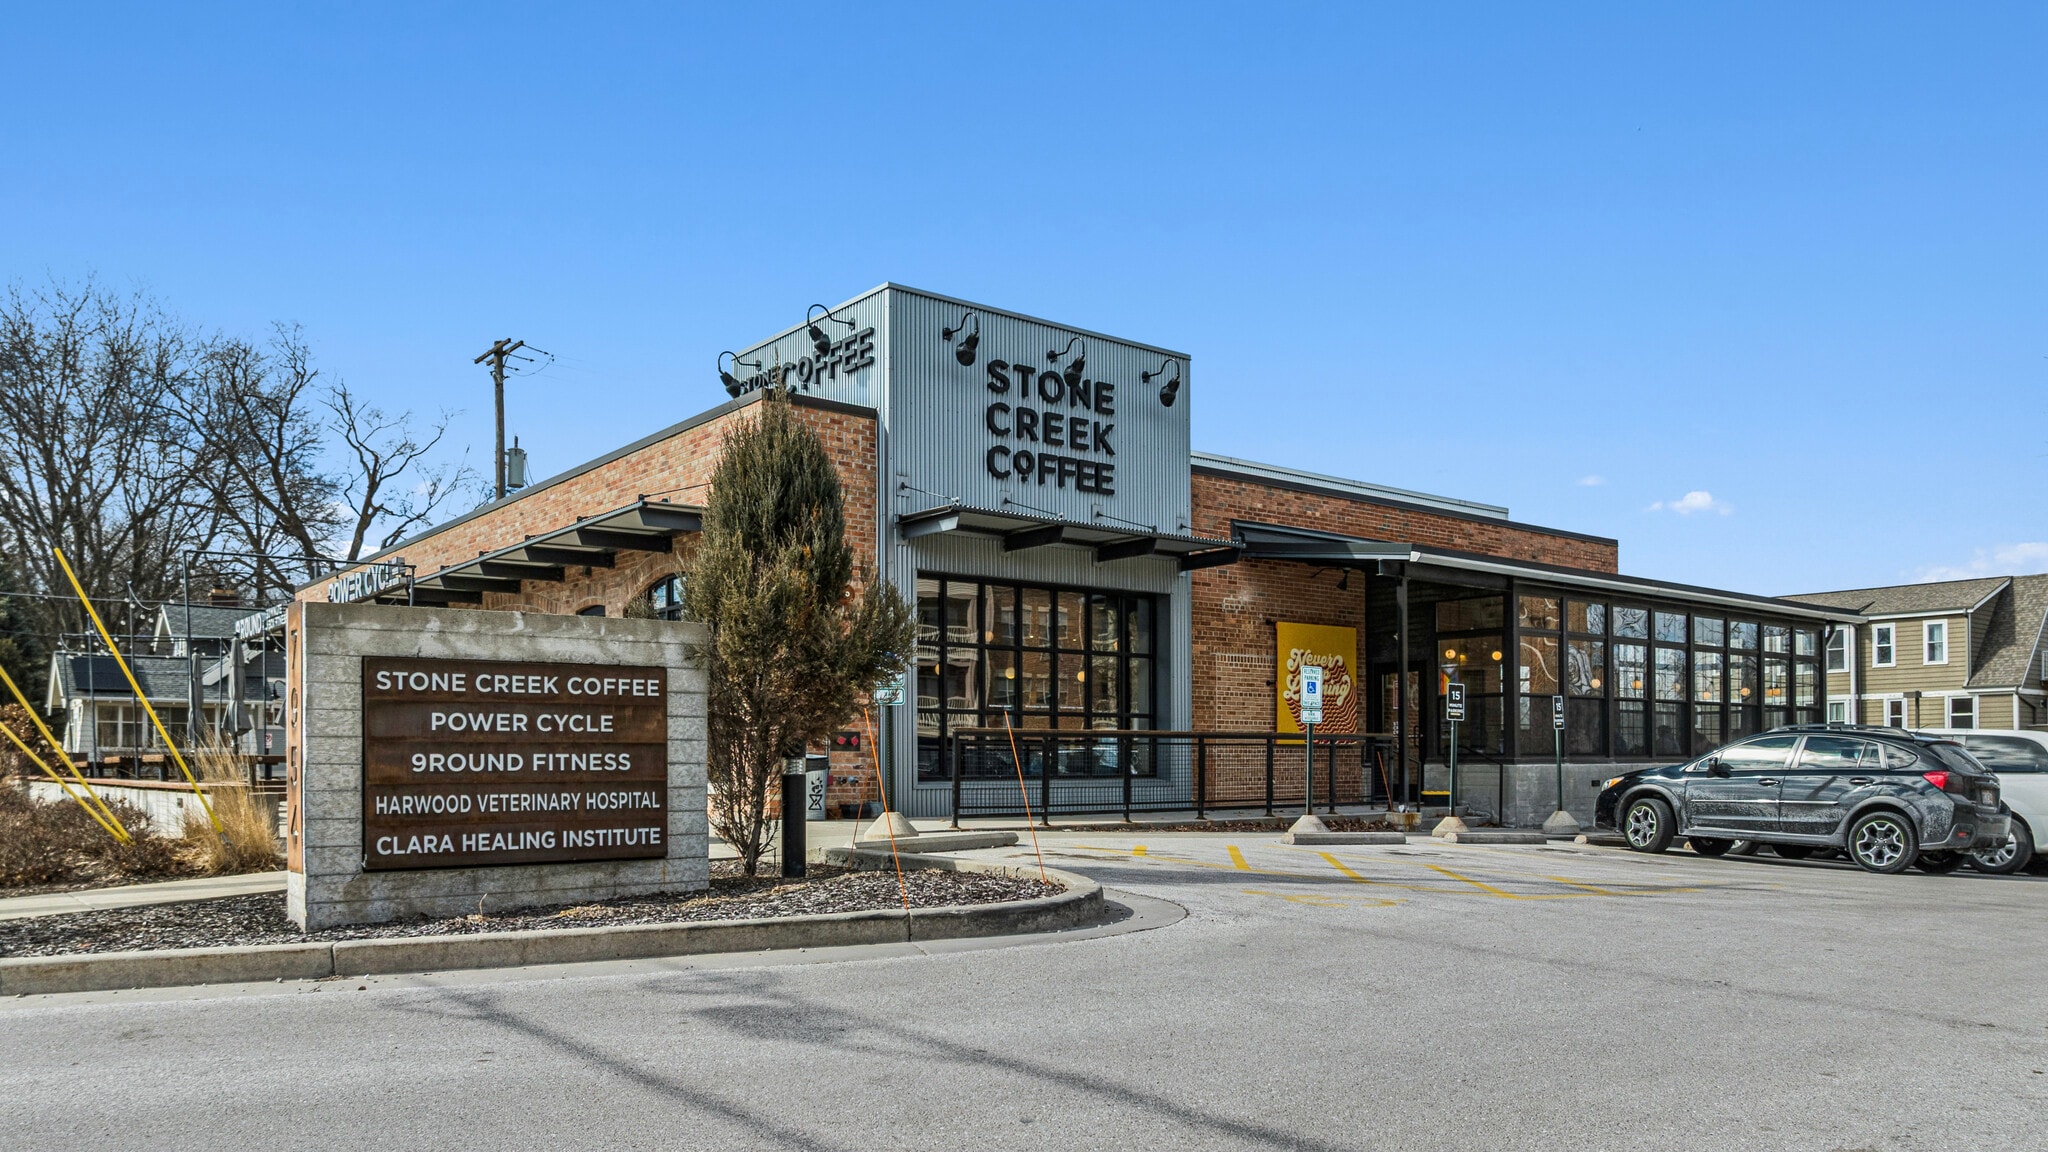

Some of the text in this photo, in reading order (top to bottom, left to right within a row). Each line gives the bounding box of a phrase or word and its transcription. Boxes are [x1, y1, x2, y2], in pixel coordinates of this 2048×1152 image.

[780, 327, 874, 394] COFFEE
[987, 359, 1115, 415] STONE
[986, 402, 1115, 456] CREEK
[986, 445, 1115, 496] COFFEE
[328, 557, 401, 603] POWER CYCLE
[1286, 648, 1344, 673] Never
[376, 670, 660, 697] STONE CREEK COFFEE
[1284, 674, 1351, 707] Lning
[1451, 691, 1461, 700] 15
[1555, 702, 1562, 711] 15
[431, 712, 614, 733] POWER CYCLE
[411, 753, 631, 773] 9ROUND FITNESS
[376, 791, 660, 815] HARWOOD VETERINARY HOSPITAL
[376, 827, 661, 856] CLARA HEALING INSTITUTE
